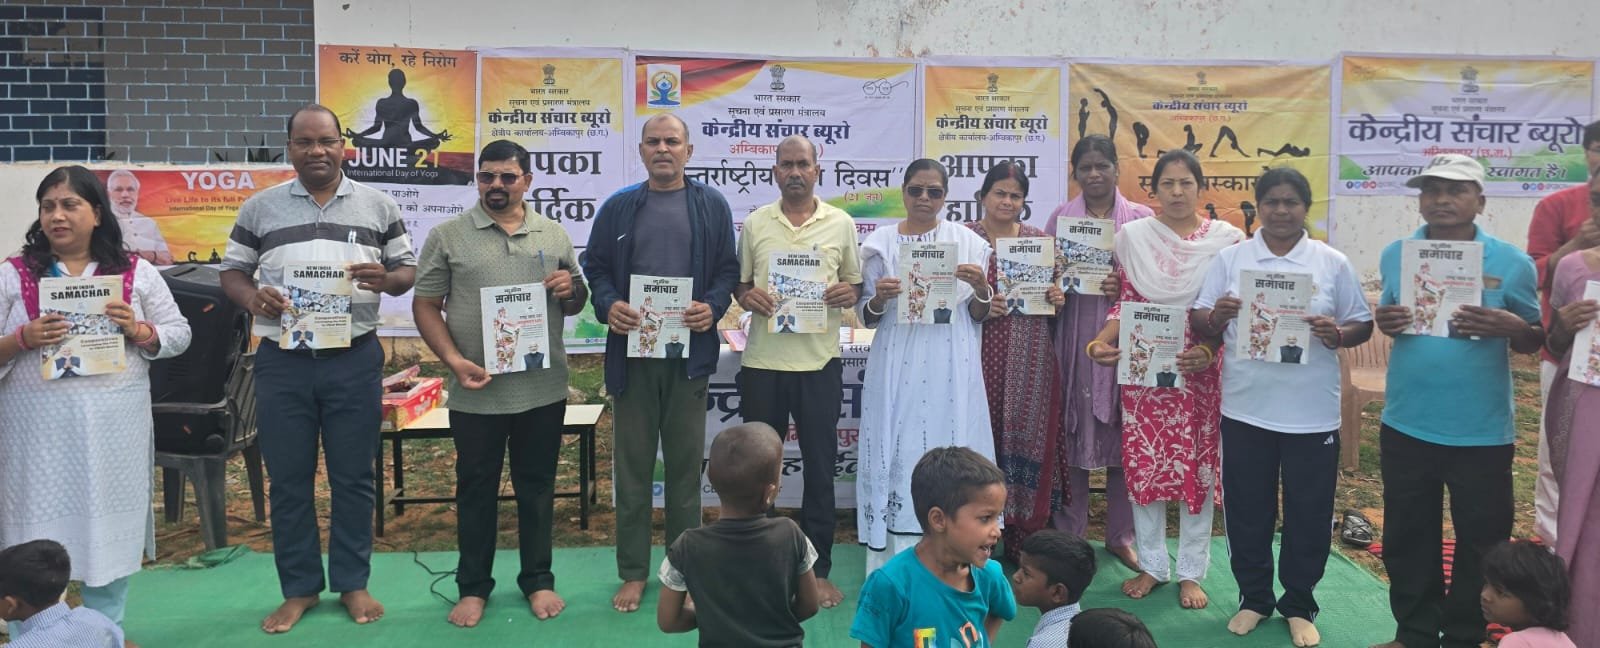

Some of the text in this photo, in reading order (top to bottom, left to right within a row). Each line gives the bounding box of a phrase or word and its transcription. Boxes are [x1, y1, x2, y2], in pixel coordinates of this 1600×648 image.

[339, 48, 458, 68] करें योग, रहे निरोग
[754, 93, 801, 103] भारत सरकार
[488, 108, 611, 128] केन्द्रीय संचार ब्यूरो
[728, 106, 826, 118] सूचना एवं प्रसारण मंत्रालय
[936, 114, 1048, 134] केन्द्रीय संचार ब्यूरो
[702, 118, 850, 144] केन्द्रीय संचार ब्यूरो
[1348, 113, 1584, 153] केन्द्रीय संचार ब्यूरो
[348, 147, 439, 168] JUNE 21
[347, 169, 394, 177] International
[396, 170, 409, 178] Day
[421, 170, 438, 179] Yoga
[1362, 166, 1424, 176] आपका
[1487, 166, 1542, 178] स्वागत
[181, 171, 255, 190] YOGA
[392, 188, 419, 198] पाओगे
[406, 202, 418, 212] को
[423, 203, 464, 214] अपनाओगे
[1069, 225, 1102, 235] समाचार
[912, 250, 945, 259] समाचार
[1008, 244, 1042, 254] समाचार
[1418, 249, 1463, 260] समाचार
[777, 258, 820, 266] SAMACHAR
[293, 270, 344, 278] SAMACHAR
[643, 284, 678, 294] समाचार
[1255, 279, 1295, 290] समाचार
[50, 288, 110, 300] SAMACHAR
[495, 292, 531, 304] समाचार
[1134, 311, 1170, 323] समाचार
